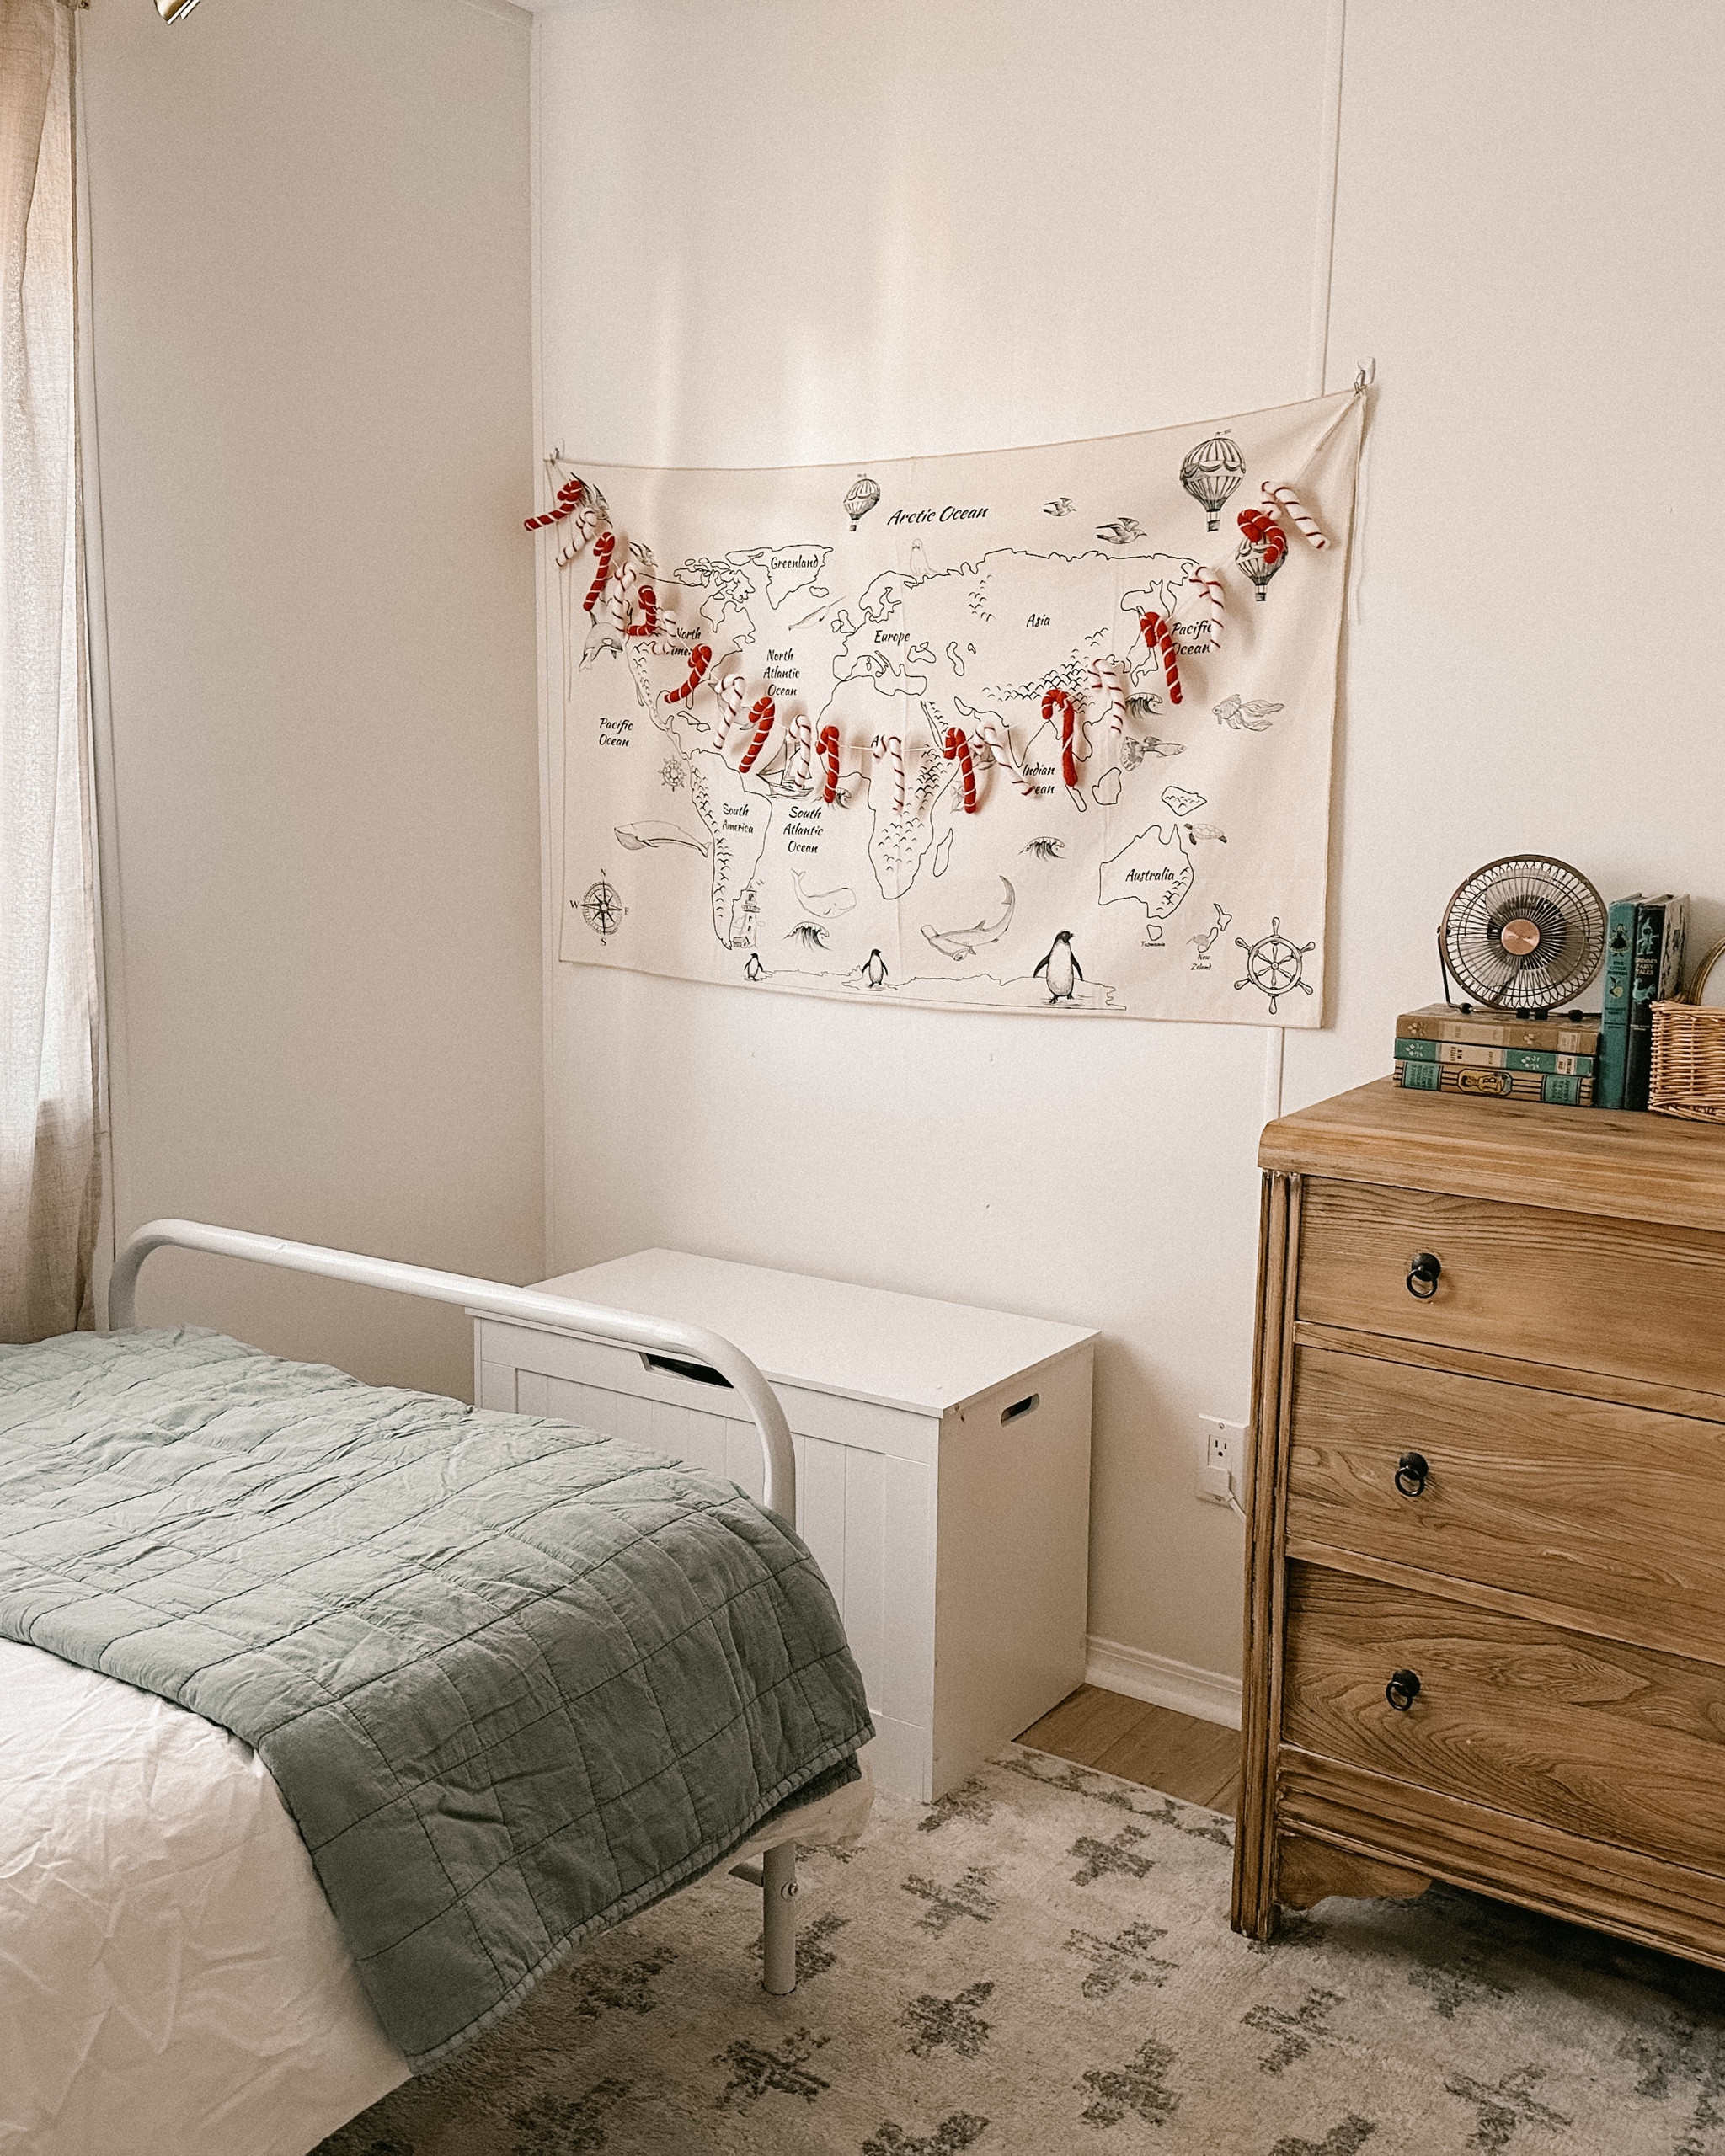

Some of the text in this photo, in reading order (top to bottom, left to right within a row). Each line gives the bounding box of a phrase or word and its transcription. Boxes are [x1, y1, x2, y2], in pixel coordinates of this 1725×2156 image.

[887, 506, 988, 526] Arctic Ocean
[771, 554, 819, 569] Greenland
[1026, 613, 1050, 627] Asia
[874, 630, 911, 646] Europe
[766, 648, 793, 661] North
[763, 666, 800, 679] Atlantic
[767, 684, 797, 696] Ocean
[599, 718, 633, 734] Pacific
[599, 734, 630, 746] Ocean
[1022, 762, 1055, 776] Indian
[1031, 785, 1055, 794] ean
[722, 803, 749, 816] South
[788, 806, 821, 819] South
[722, 820, 754, 834] America
[783, 823, 824, 836] Atlantic
[788, 841, 819, 853] Ocean
[1125, 867, 1174, 882] Australia
[569, 900, 580, 909] W
[624, 907, 629, 915] E
[601, 937, 606, 947] S
